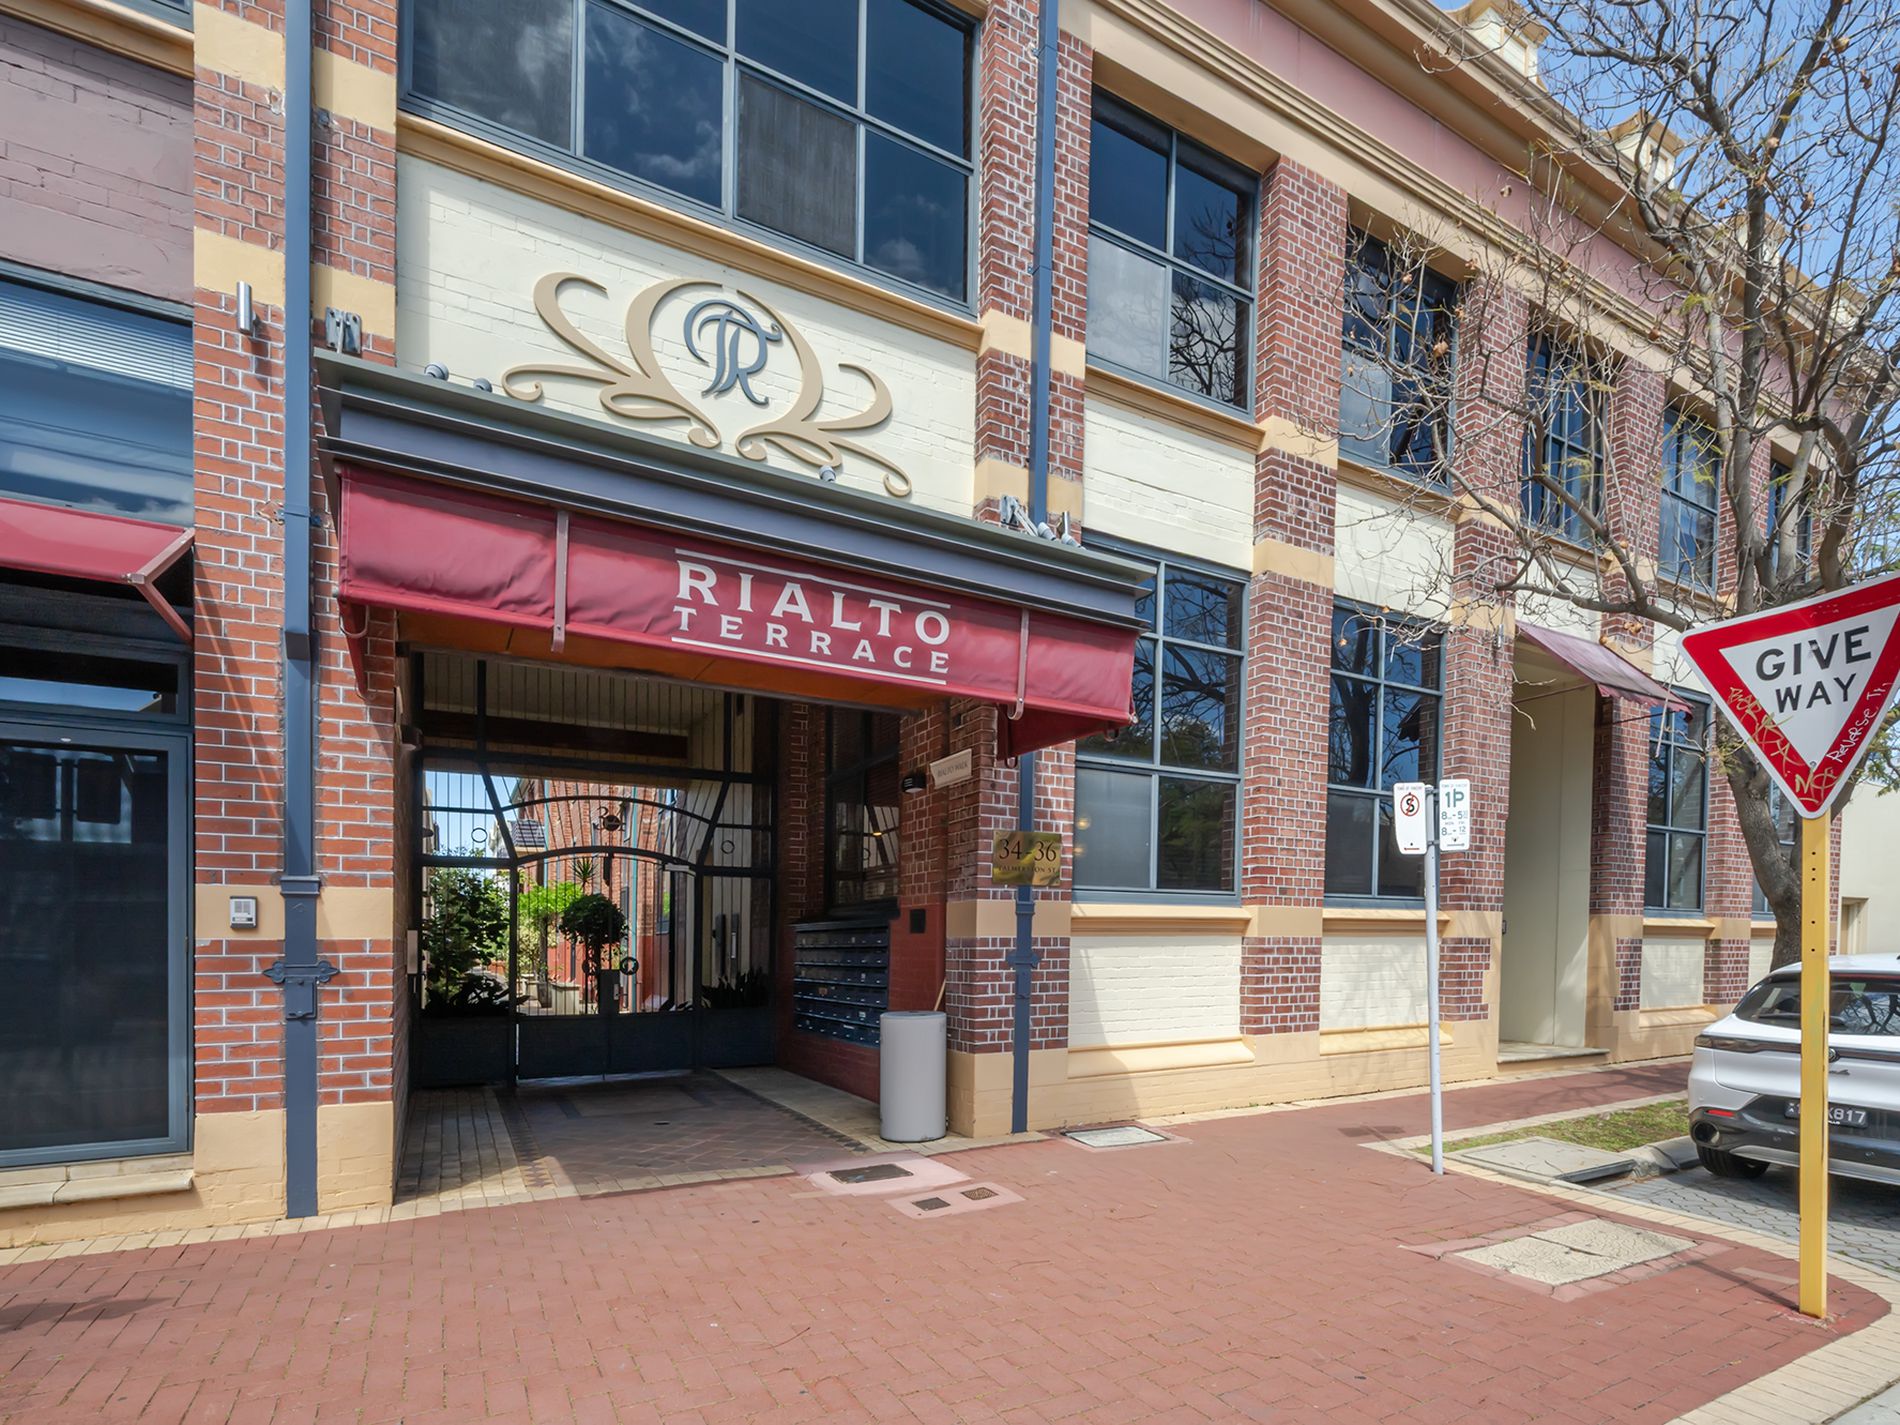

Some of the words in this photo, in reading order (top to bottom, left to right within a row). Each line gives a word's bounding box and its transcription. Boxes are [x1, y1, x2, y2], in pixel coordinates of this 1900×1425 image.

[675, 559, 950, 646] RIALTO
[672, 605, 950, 674] TERRACE
[1756, 625, 1872, 682] GIVE
[1775, 673, 1857, 714] WAY
[1445, 788, 1464, 808] 1P
